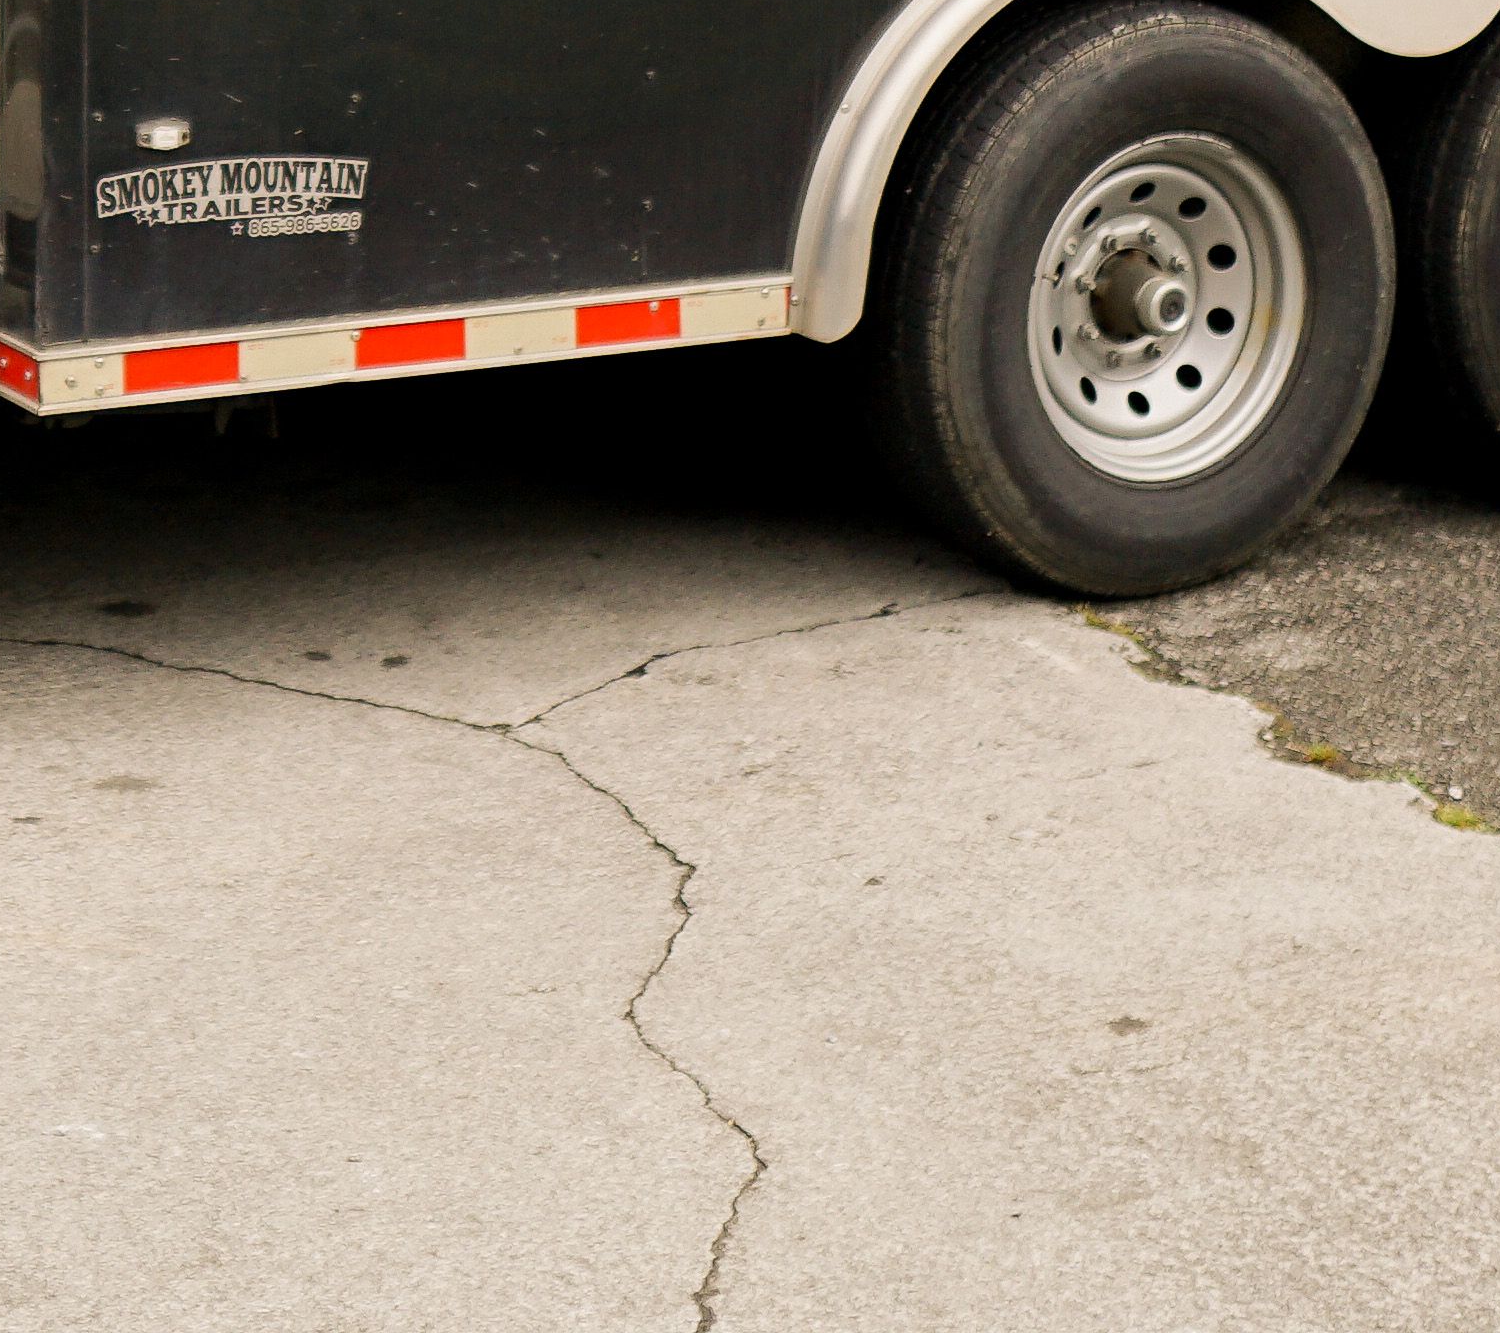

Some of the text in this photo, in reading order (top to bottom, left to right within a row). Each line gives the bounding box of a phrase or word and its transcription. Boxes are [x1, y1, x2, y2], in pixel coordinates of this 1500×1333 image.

[99, 160, 366, 214] SMOKEY MOUNTAIN
[162, 194, 304, 221] TRAILERS
[249, 213, 361, 236] 865-986-5626
